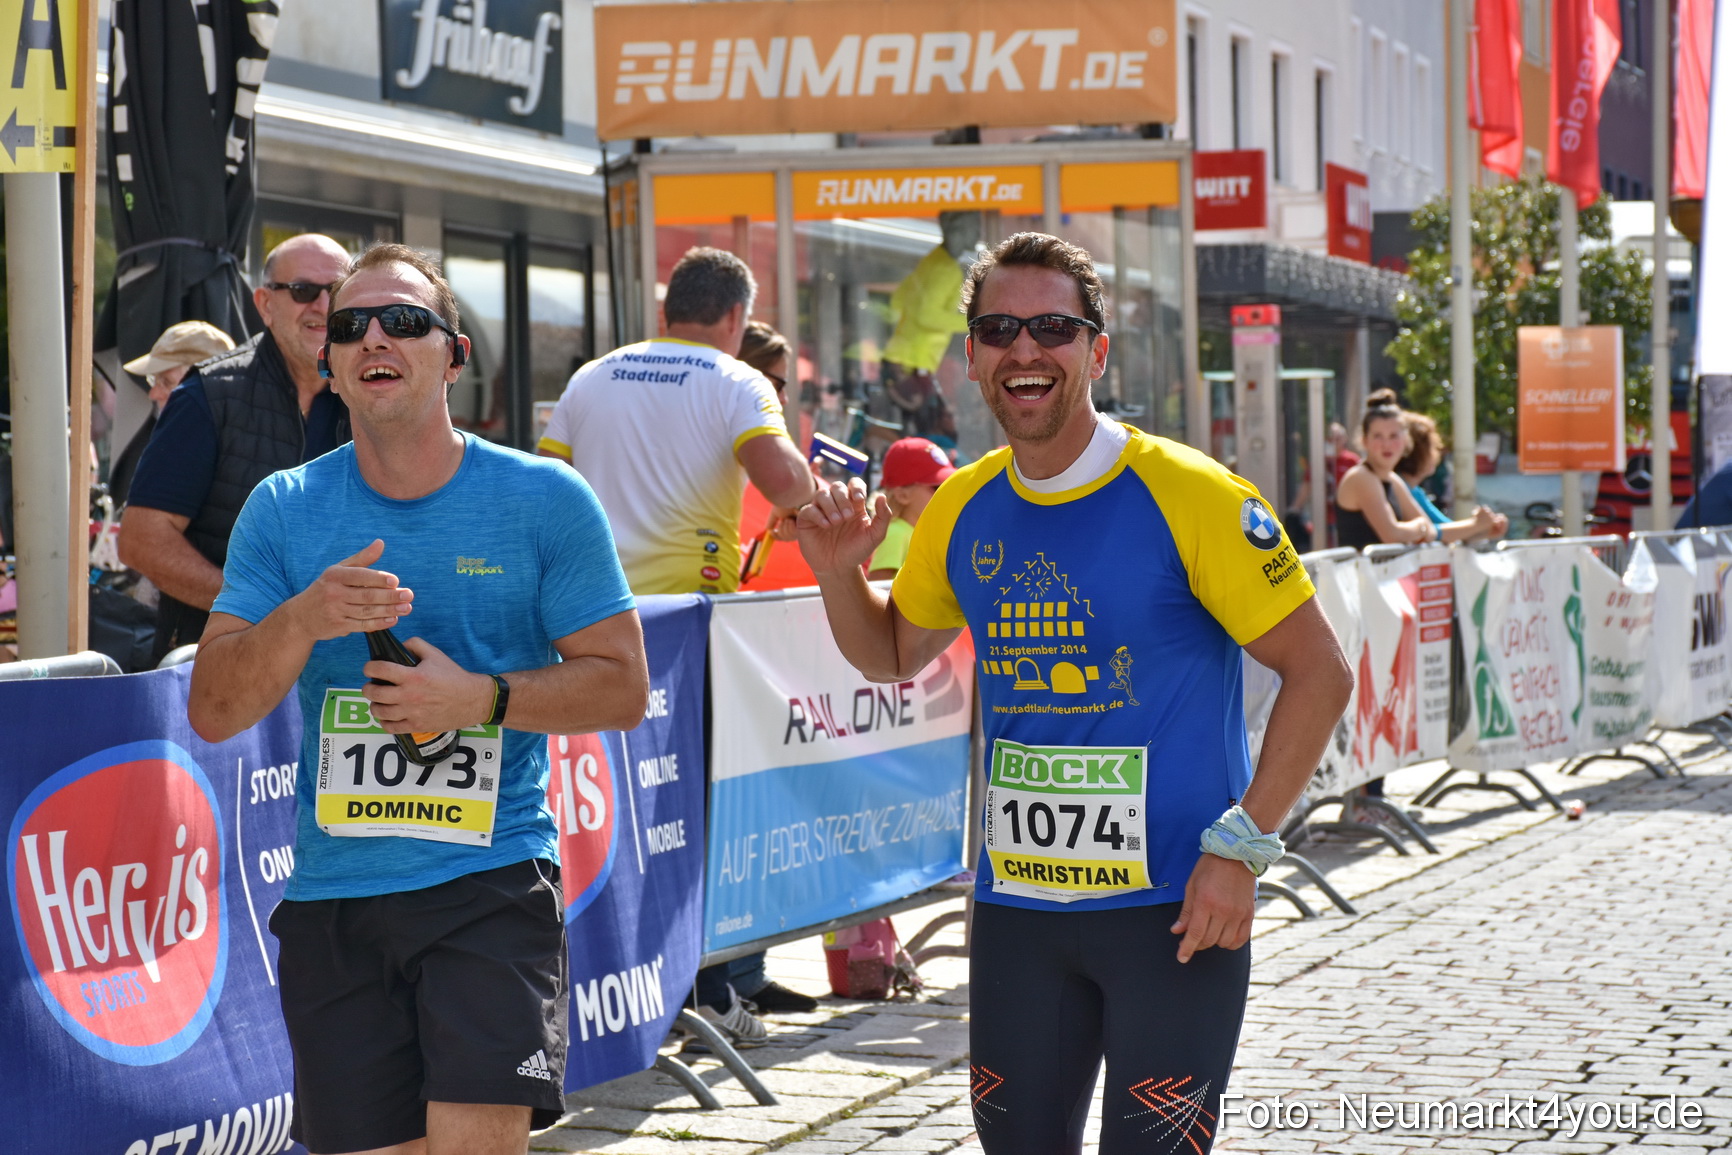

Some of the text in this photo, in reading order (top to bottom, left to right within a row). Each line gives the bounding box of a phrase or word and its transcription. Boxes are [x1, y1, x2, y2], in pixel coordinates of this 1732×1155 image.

[11, 0, 67, 90] A
[613, 28, 1148, 105] RUNMARKT.DE
[816, 175, 1024, 206] RUNMARKT.DE
[1195, 176, 1252, 199] WITT
[621, 353, 716, 370] Neumarkter
[611, 369, 690, 386] Stadtlauf
[977, 556, 997, 566] Jahre
[983, 544, 993, 553] 15
[1262, 546, 1296, 579] PART
[1061, 645, 1088, 655] 2014
[992, 700, 1124, 714] www.stadtlauf-neumarkt.de
[638, 753, 679, 789] ONLINE
[1000, 749, 1130, 789] BOCK
[347, 801, 463, 823] DOMINIC
[1002, 799, 1124, 850] 1074
[646, 819, 686, 856] MOBILE
[719, 788, 962, 887] AUF JEDER STRECKE ZUHAUSE
[1003, 859, 1130, 885] CHRISTIAN
[22, 824, 208, 983] Hervis
[715, 912, 753, 936] railone.de
[80, 970, 147, 1018] SPORTS
[575, 953, 664, 1042] MOVIN'
[516, 1066, 551, 1081] adidas
